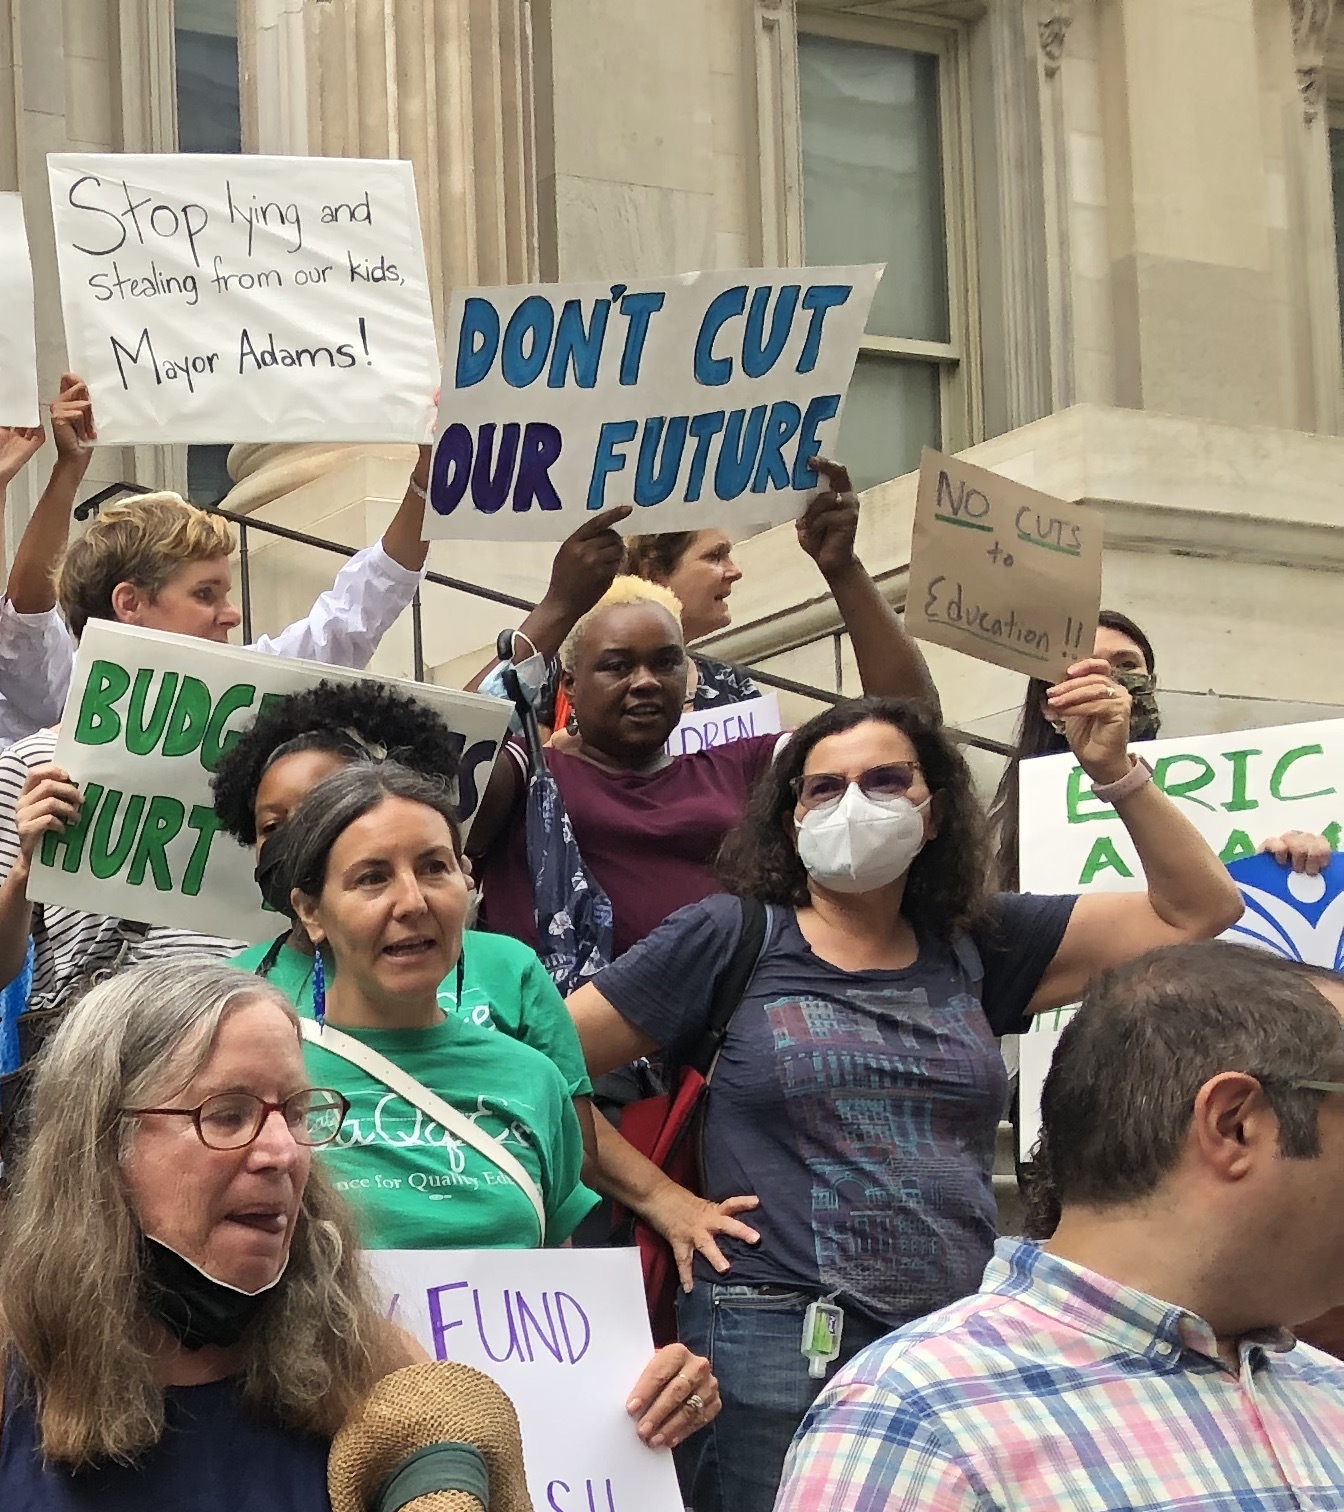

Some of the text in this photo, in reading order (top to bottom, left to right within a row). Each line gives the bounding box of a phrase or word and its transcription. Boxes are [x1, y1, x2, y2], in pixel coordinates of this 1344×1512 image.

[70, 177, 372, 267] Stop lying and
[212, 256, 282, 293] from
[295, 264, 333, 286] our
[348, 251, 405, 287] kids,
[110, 317, 373, 393] Mayor Adams!
[456, 284, 853, 389] DON'T CUT
[430, 394, 841, 515] OUR FUTURE
[936, 469, 1082, 548] NO CUTS
[987, 541, 1013, 568] to
[924, 576, 1050, 652] Education
[74, 659, 285, 772] BUDG
[1066, 744, 1337, 824] ERIC
[41, 782, 222, 896] HURT
[375, 1174, 402, 1190] for
[408, 1172, 479, 1191] Quality
[426, 1280, 592, 1366] FUND
